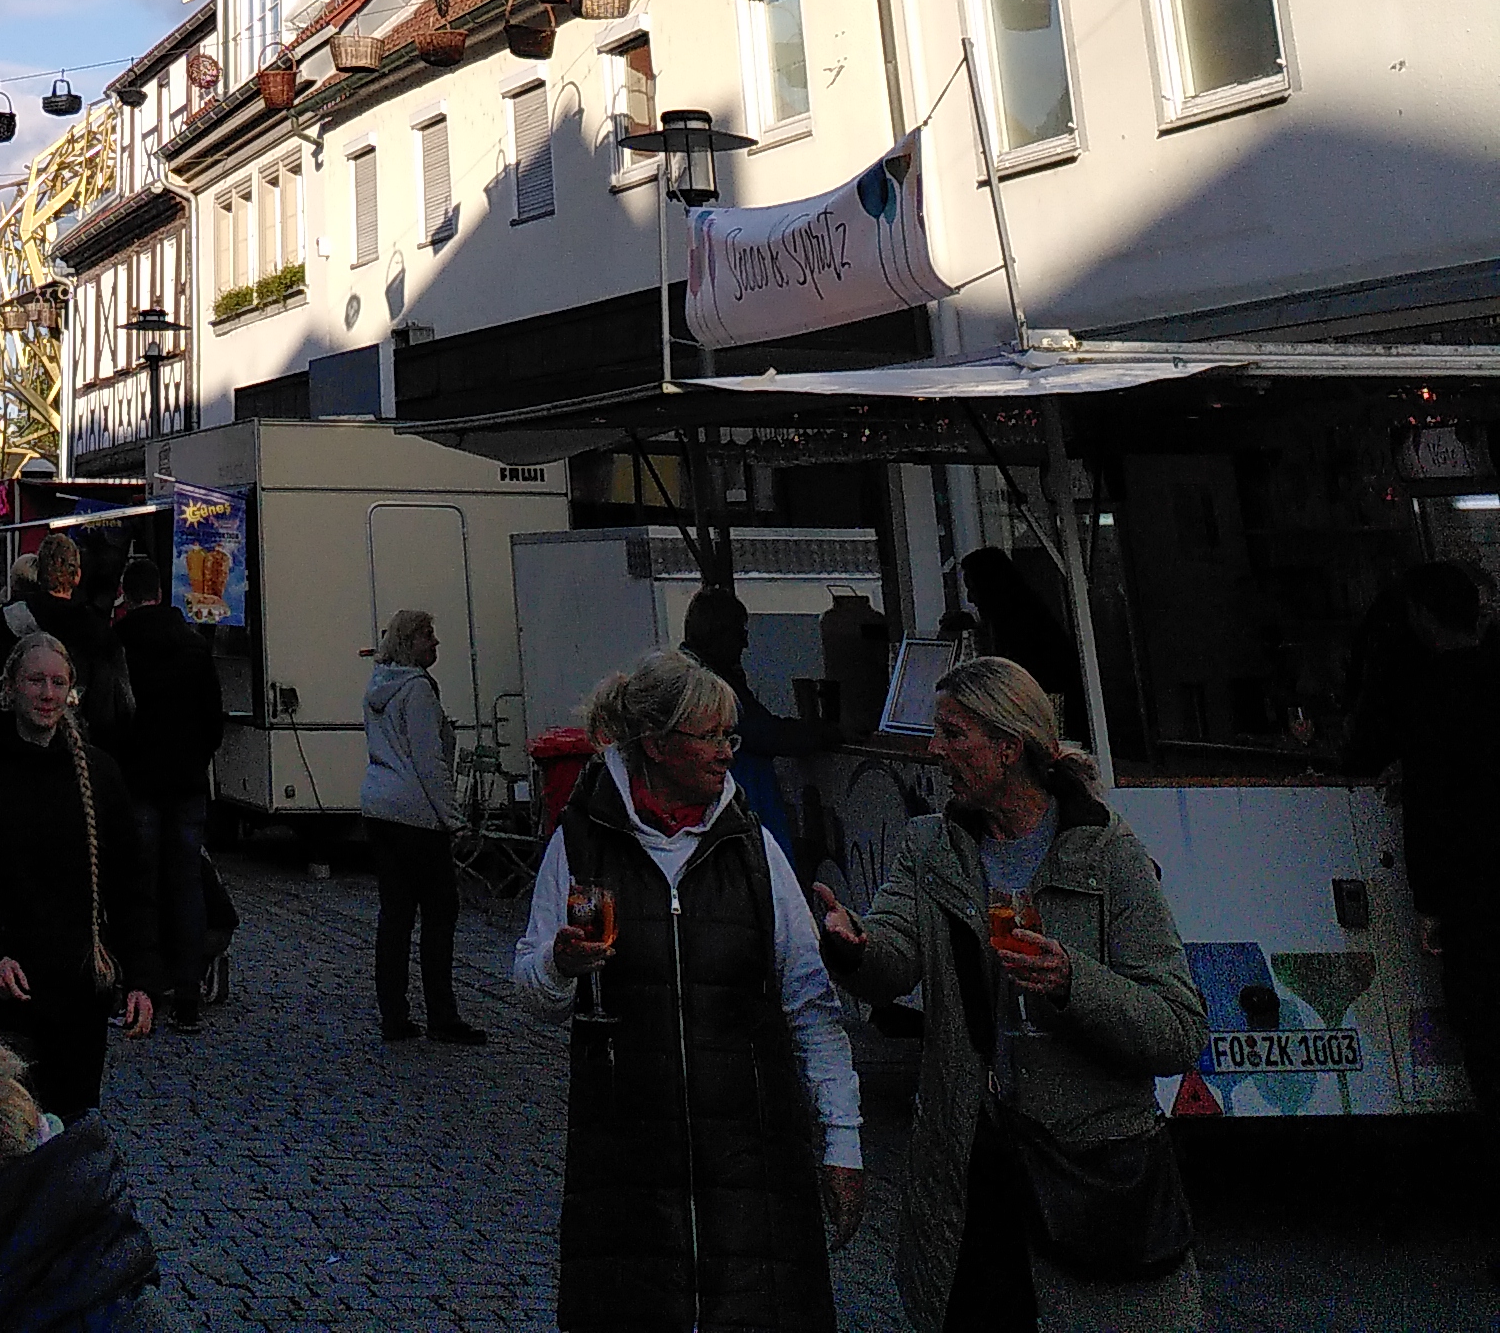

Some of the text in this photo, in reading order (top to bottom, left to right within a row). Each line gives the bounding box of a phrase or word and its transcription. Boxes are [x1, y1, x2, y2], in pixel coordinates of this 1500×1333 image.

[1213, 1035, 1358, 1067] FO ZK 1003
